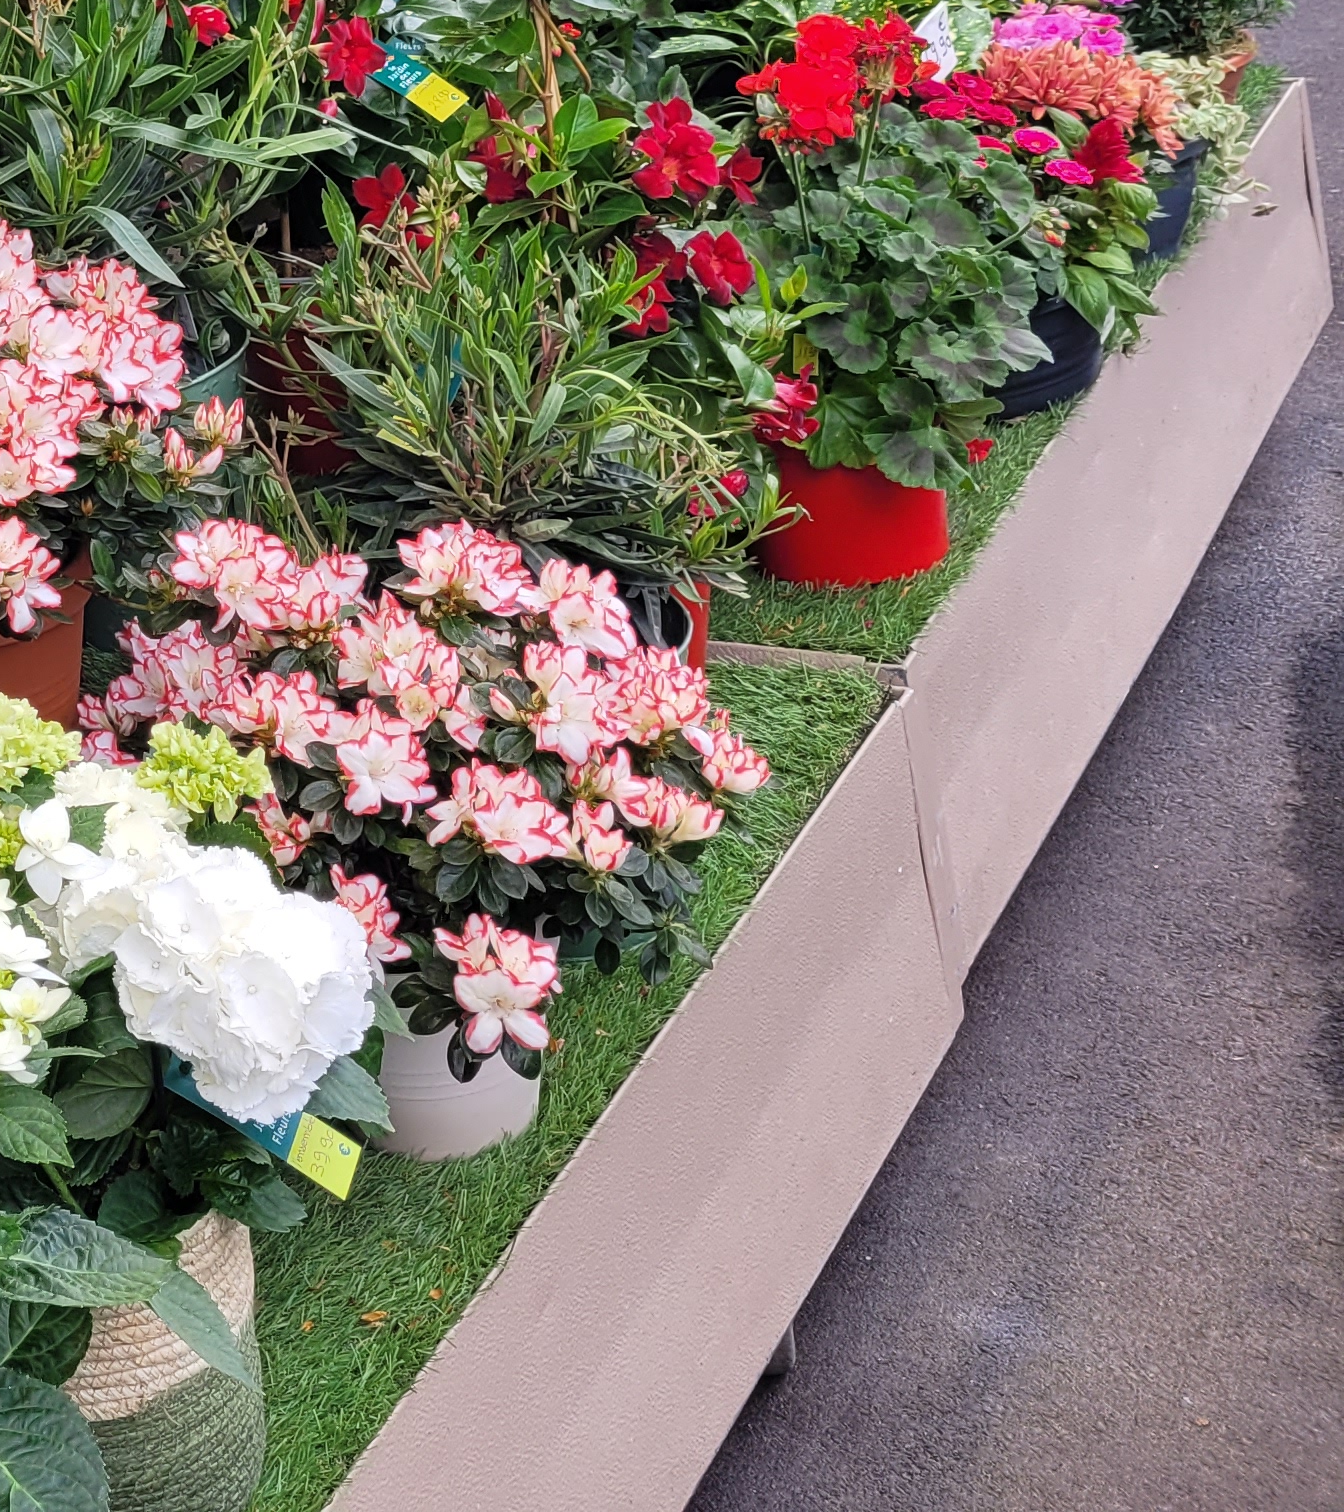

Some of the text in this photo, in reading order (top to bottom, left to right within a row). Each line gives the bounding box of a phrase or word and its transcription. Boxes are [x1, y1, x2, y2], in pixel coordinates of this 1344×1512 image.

[395, 42, 422, 51] Fleurs
[387, 62, 411, 81] Jardin
[399, 71, 411, 81] des
[399, 70, 422, 89] Fleurs
[271, 1112, 293, 1146] Fleurs
